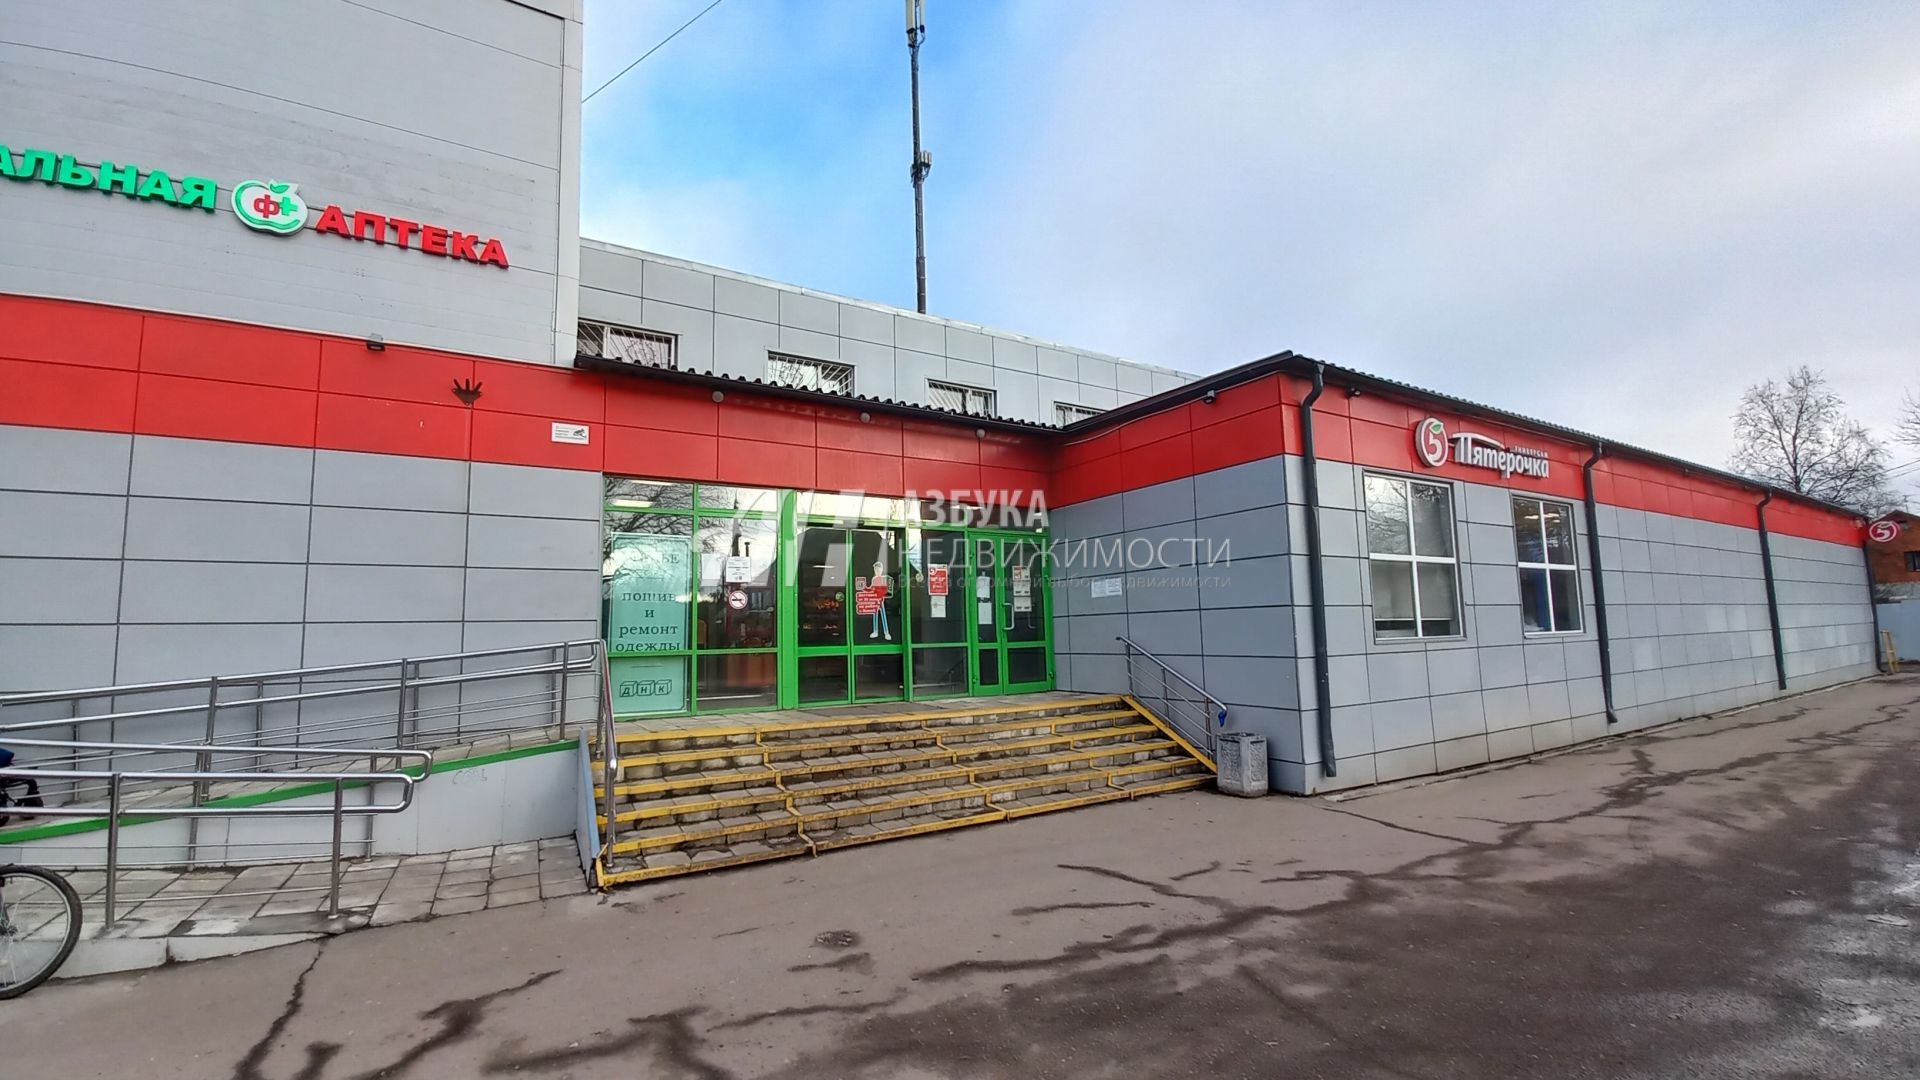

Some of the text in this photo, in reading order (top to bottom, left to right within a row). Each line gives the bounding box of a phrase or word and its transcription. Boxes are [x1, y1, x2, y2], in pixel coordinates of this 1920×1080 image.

[315, 204, 509, 269] АПТЕКА
[644, 609, 655, 618] и
[619, 625, 678, 638] ремонт
[616, 642, 680, 652] одежды
